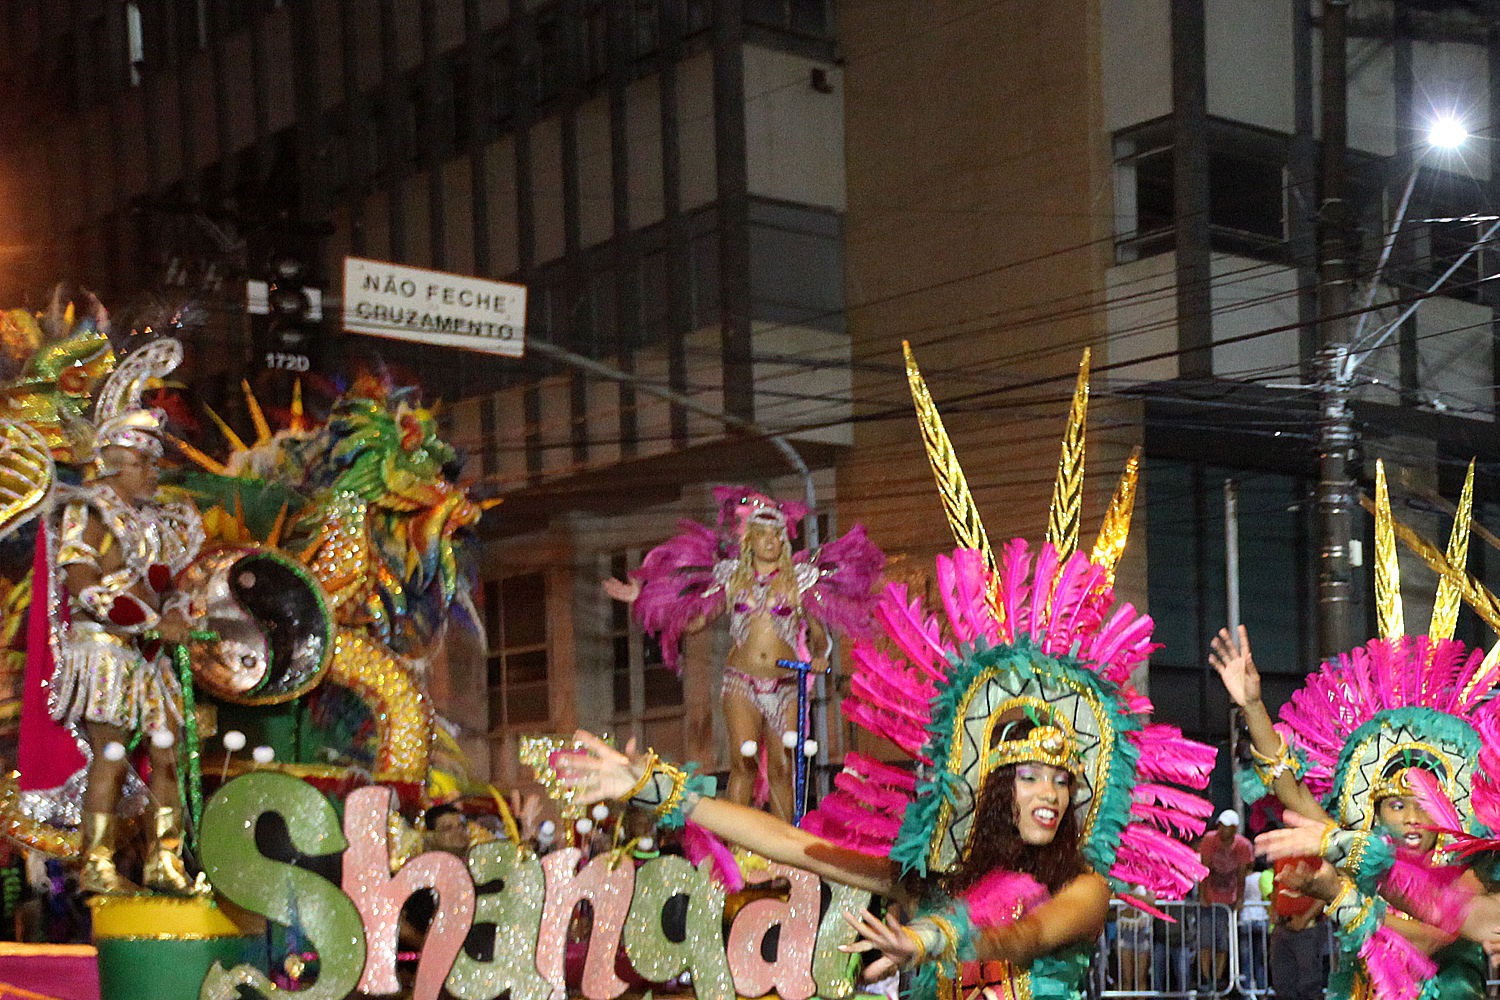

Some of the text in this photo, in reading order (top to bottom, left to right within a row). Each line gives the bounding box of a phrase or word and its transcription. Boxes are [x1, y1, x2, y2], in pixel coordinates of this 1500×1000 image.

[363, 273, 507, 314] NÃO FECHE
[355, 300, 514, 341] CRUZAMENTO
